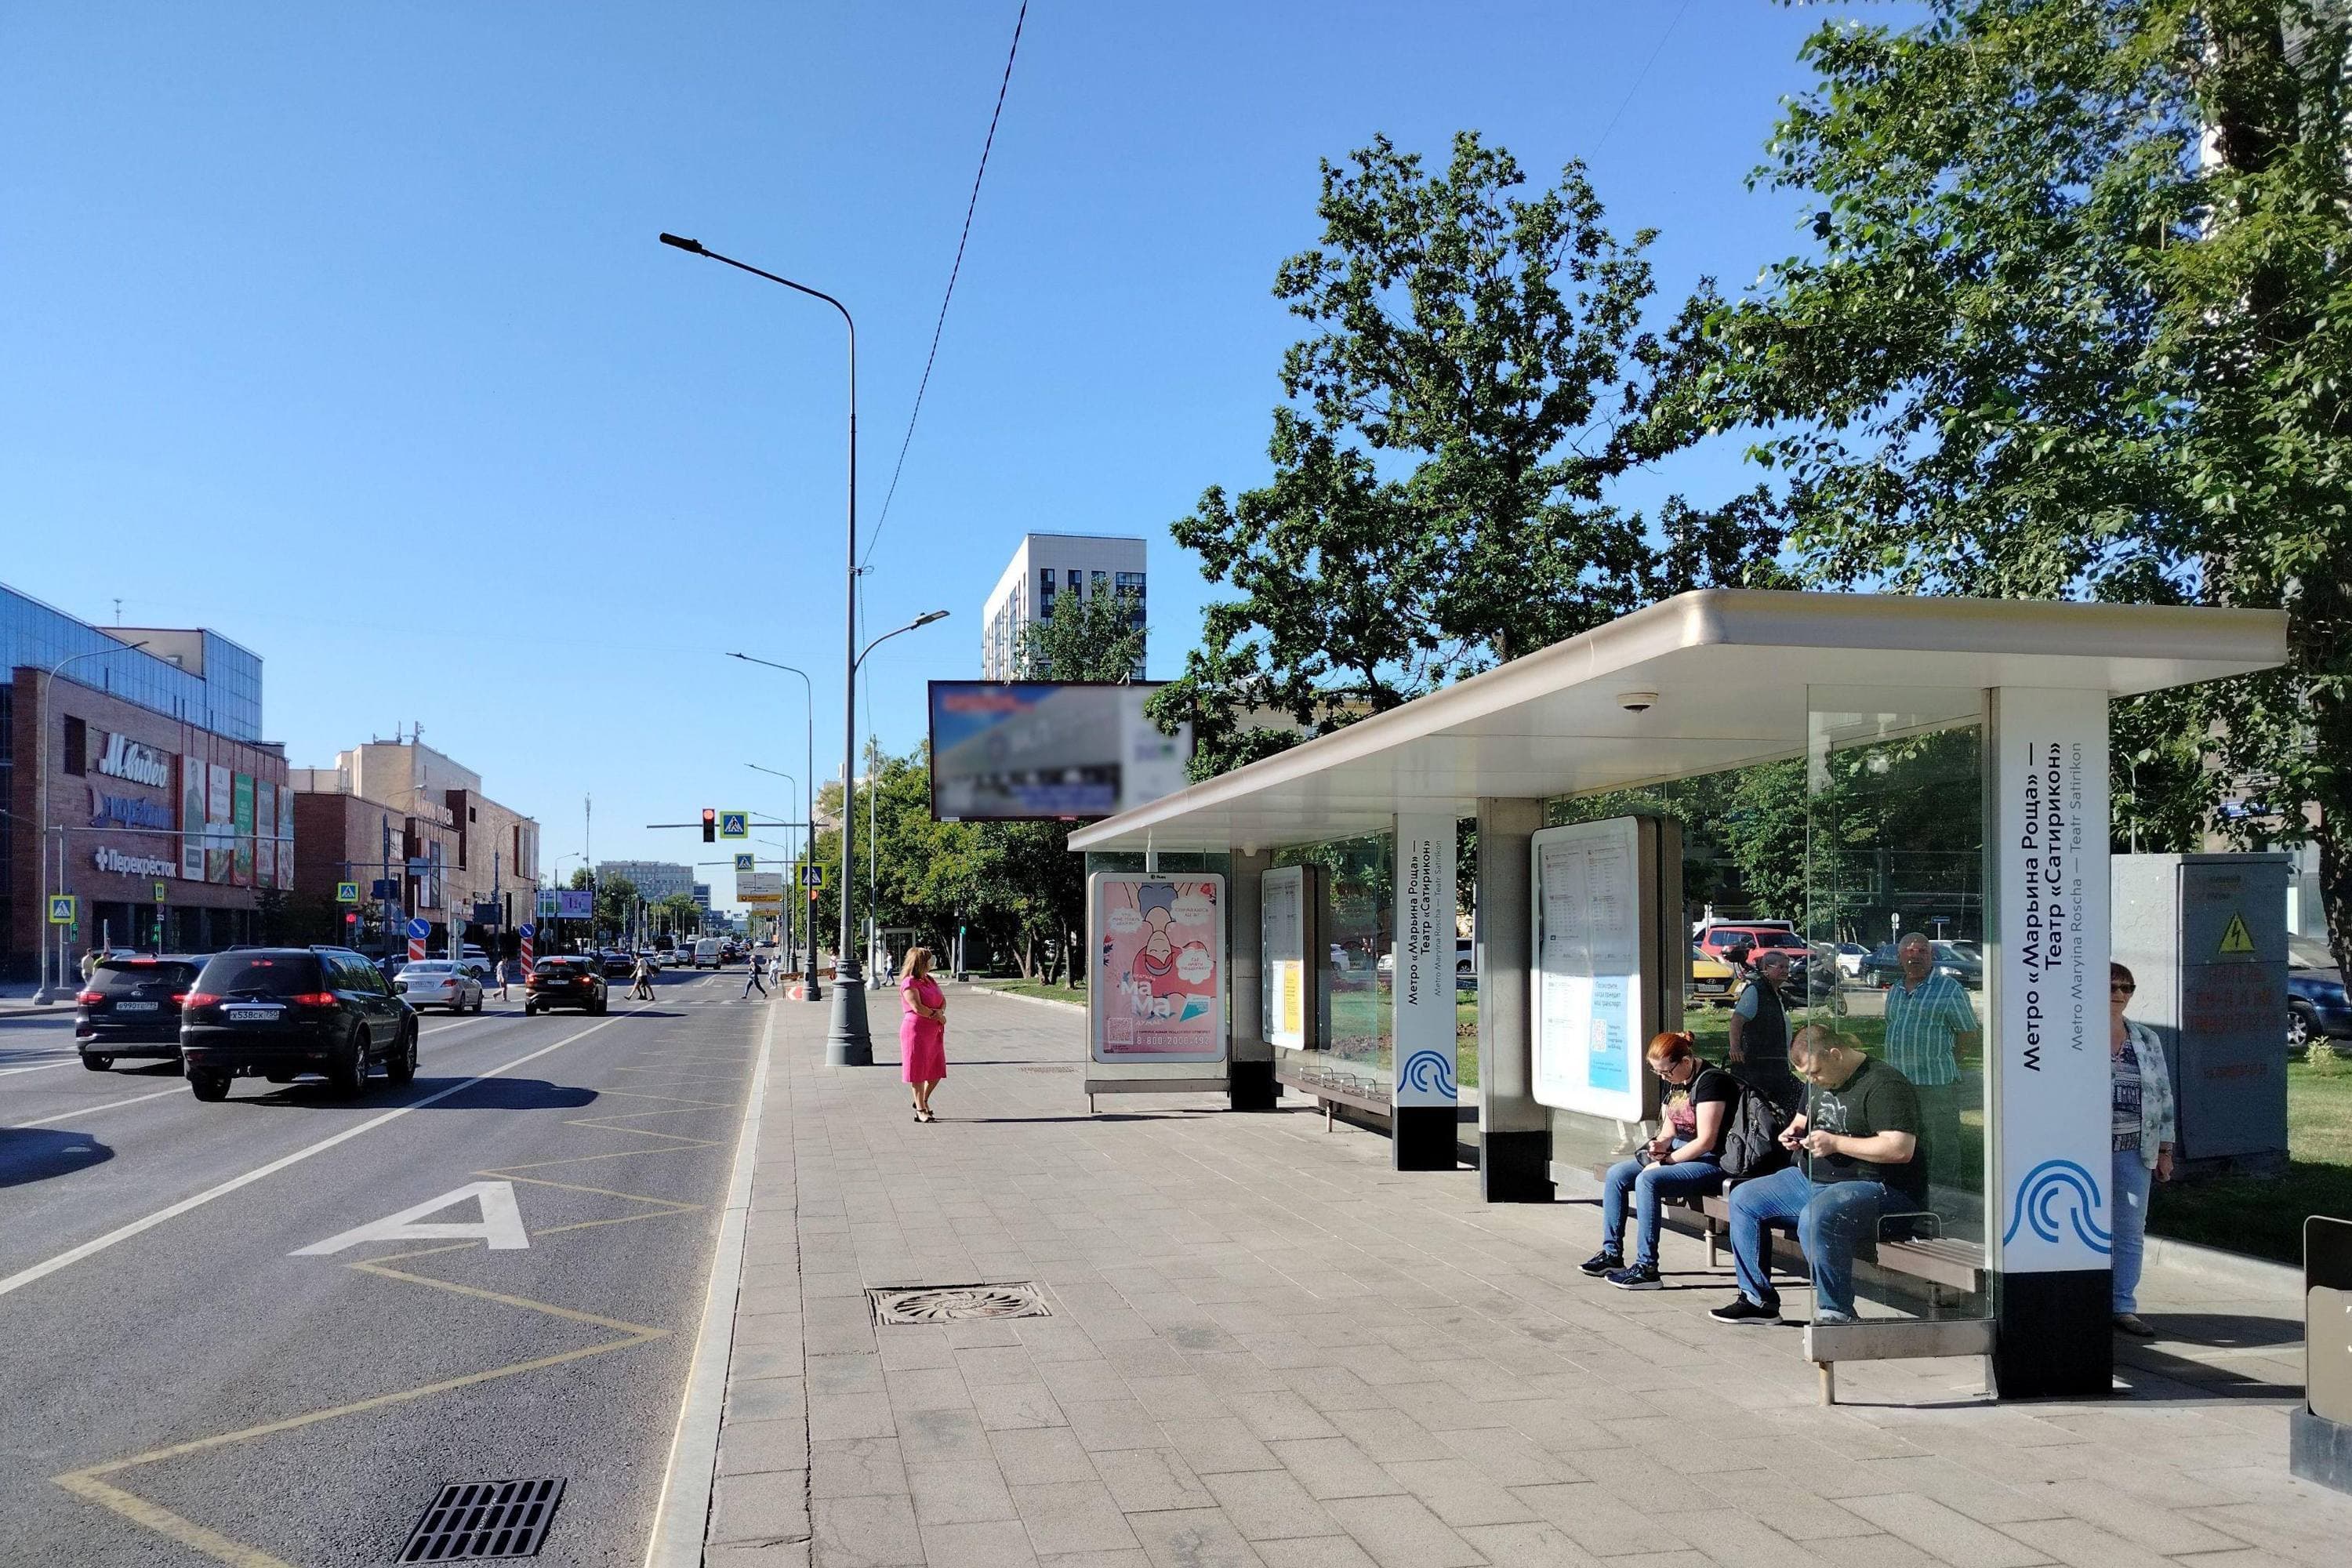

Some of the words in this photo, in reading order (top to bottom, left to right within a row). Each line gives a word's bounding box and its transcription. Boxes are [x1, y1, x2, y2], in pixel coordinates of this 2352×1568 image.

[2069, 742, 2082, 810] Satirikon
[2022, 774, 2041, 849] Роща»
[2045, 742, 2065, 896] «Сатирикон»
[2070, 815, 2082, 854] Teatr
[107, 848, 176, 879] Перекрёсток
[1408, 856, 1419, 895] Роща»
[1421, 840, 1432, 918] «Сатирикон»
[1408, 898, 1420, 961] «Марьина
[2023, 858, 2043, 983] «Марьина
[2070, 879, 2083, 931] Roscha
[1421, 921, 1432, 956] Театр
[2045, 904, 2066, 971] Театр
[2070, 936, 2085, 1000] Maryina
[1408, 964, 1420, 1006] Метро
[2024, 991, 2043, 1072] Метро
[2071, 1004, 2083, 1051] Metro
